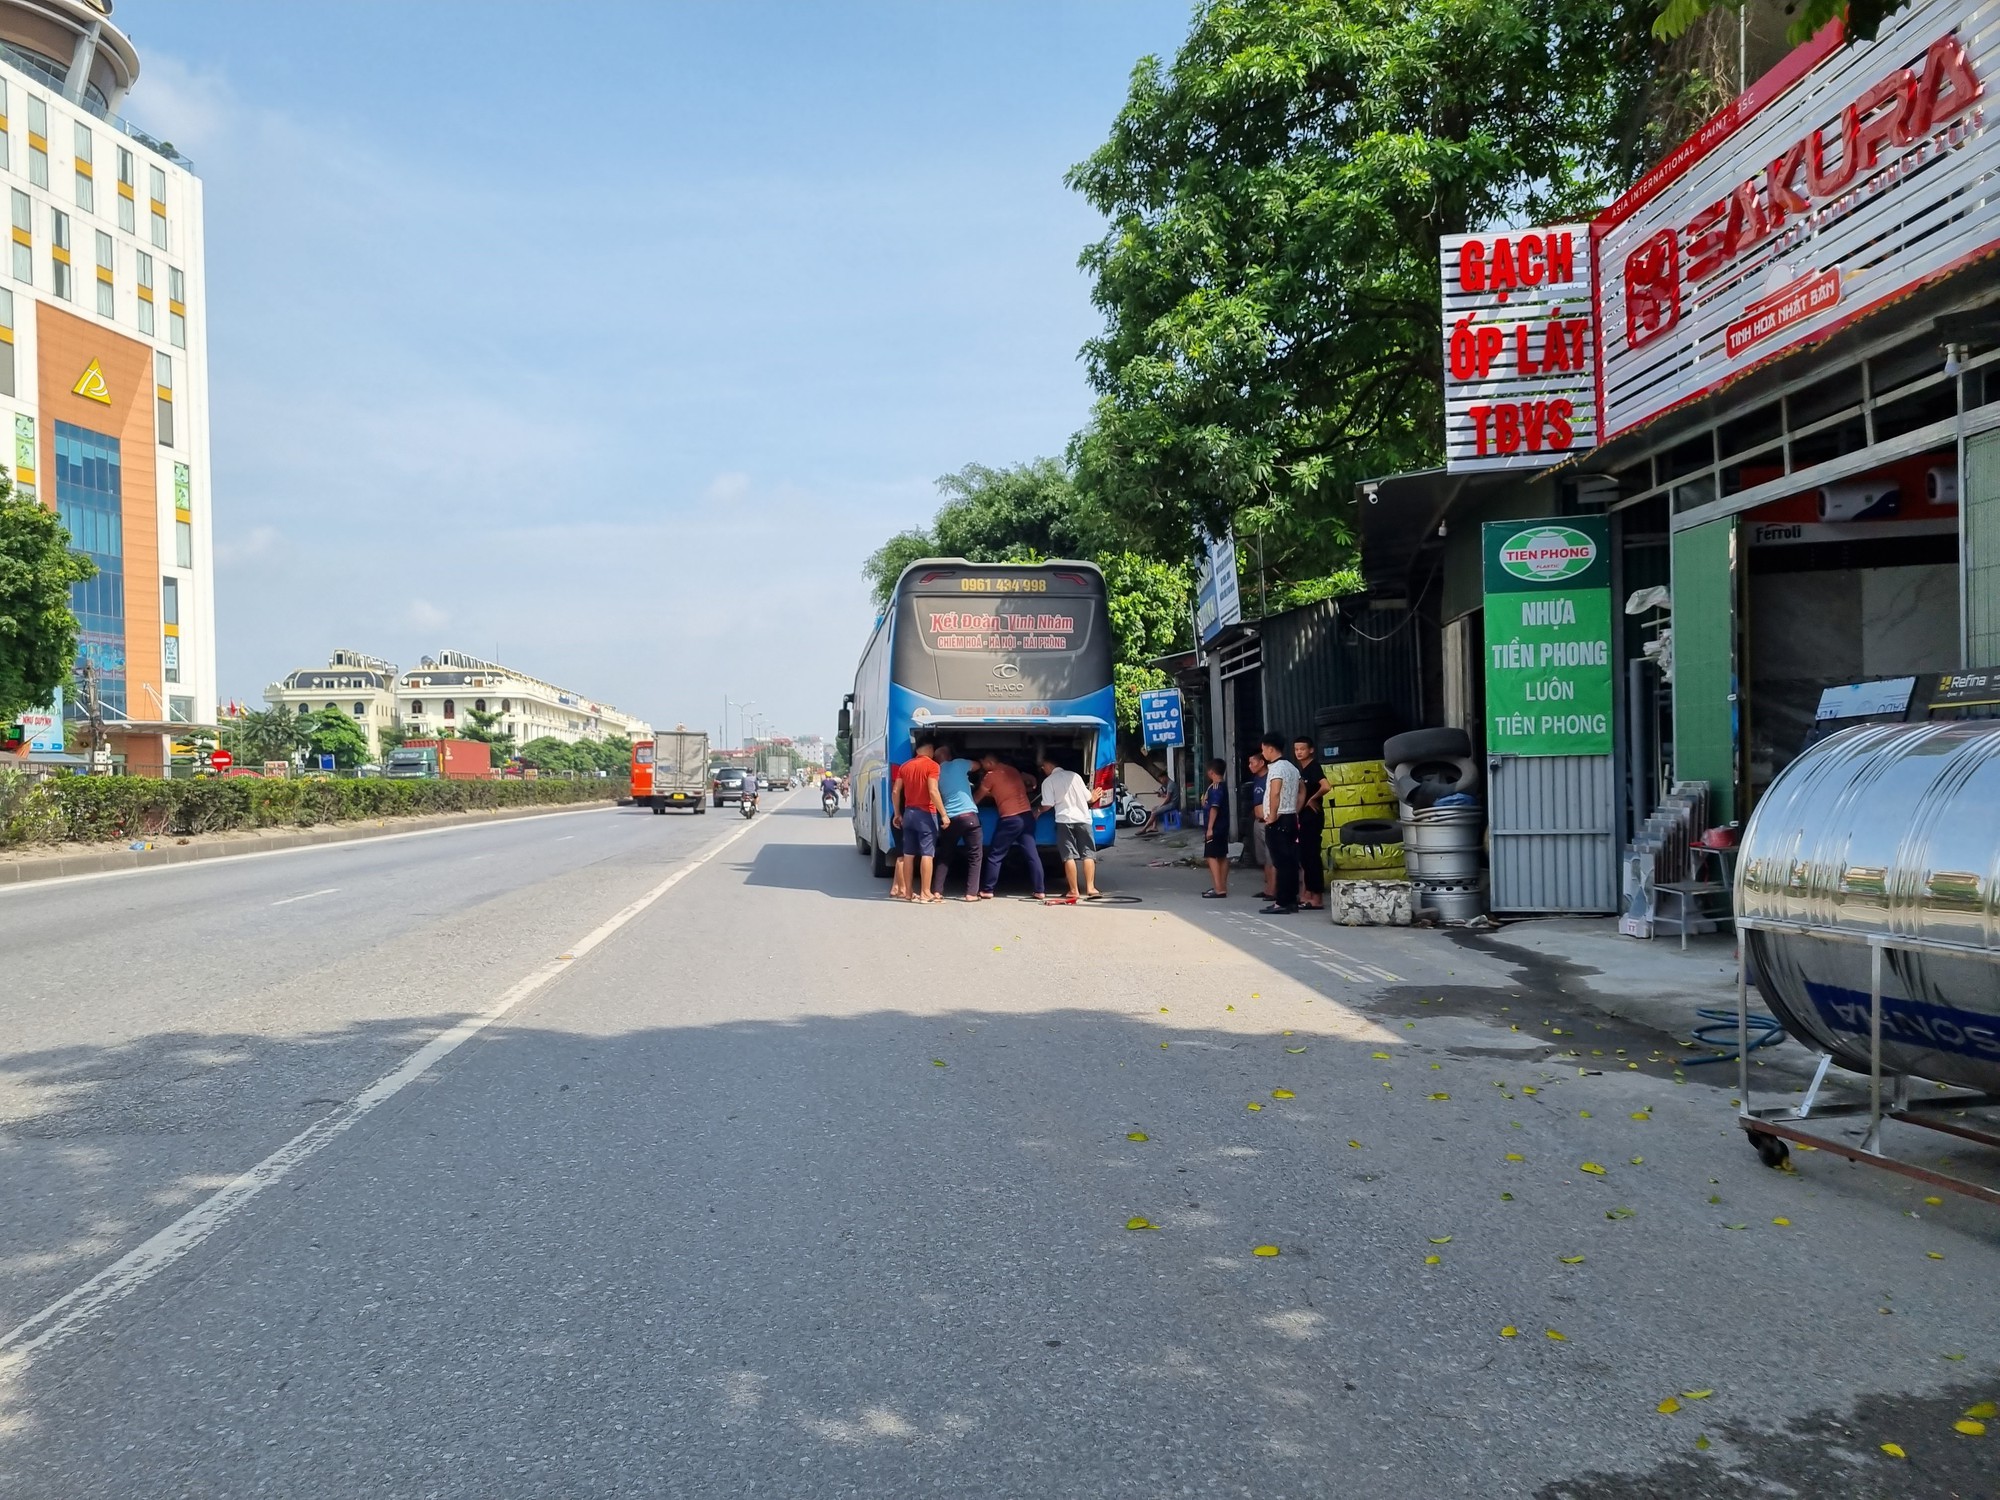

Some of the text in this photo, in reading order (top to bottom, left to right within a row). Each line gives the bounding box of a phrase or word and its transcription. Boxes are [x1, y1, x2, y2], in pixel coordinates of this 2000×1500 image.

[1686, 34, 1986, 284] SAKURA
[1611, 201, 1629, 219] ASIA
[1630, 144, 1695, 203] INTERNATIONAL
[1460, 232, 1573, 303] GẠCH
[1729, 278, 1835, 349] TINH HOA NHẬT BẢN
[1449, 307, 1589, 381] ỐP LÁT
[1469, 398, 1575, 456] TBVS
[1755, 524, 1802, 543] Ferroli
[1506, 547, 1590, 561] TIEN PHONG
[961, 578, 1047, 592] 0961 434 998
[1522, 598, 1576, 630] NHỰA
[988, 634, 1000, 649] HÀ
[1000, 634, 1017, 651] NỘI
[1023, 632, 1038, 649] HẢI
[1039, 634, 1067, 649] PHÒNG
[1492, 637, 1608, 668] TIỀN PHONG
[986, 683, 1025, 692] THACO
[1526, 676, 1575, 701] LUÔN
[1951, 675, 1988, 689] Refina
[1495, 712, 1607, 735] TIÊN PHONG
